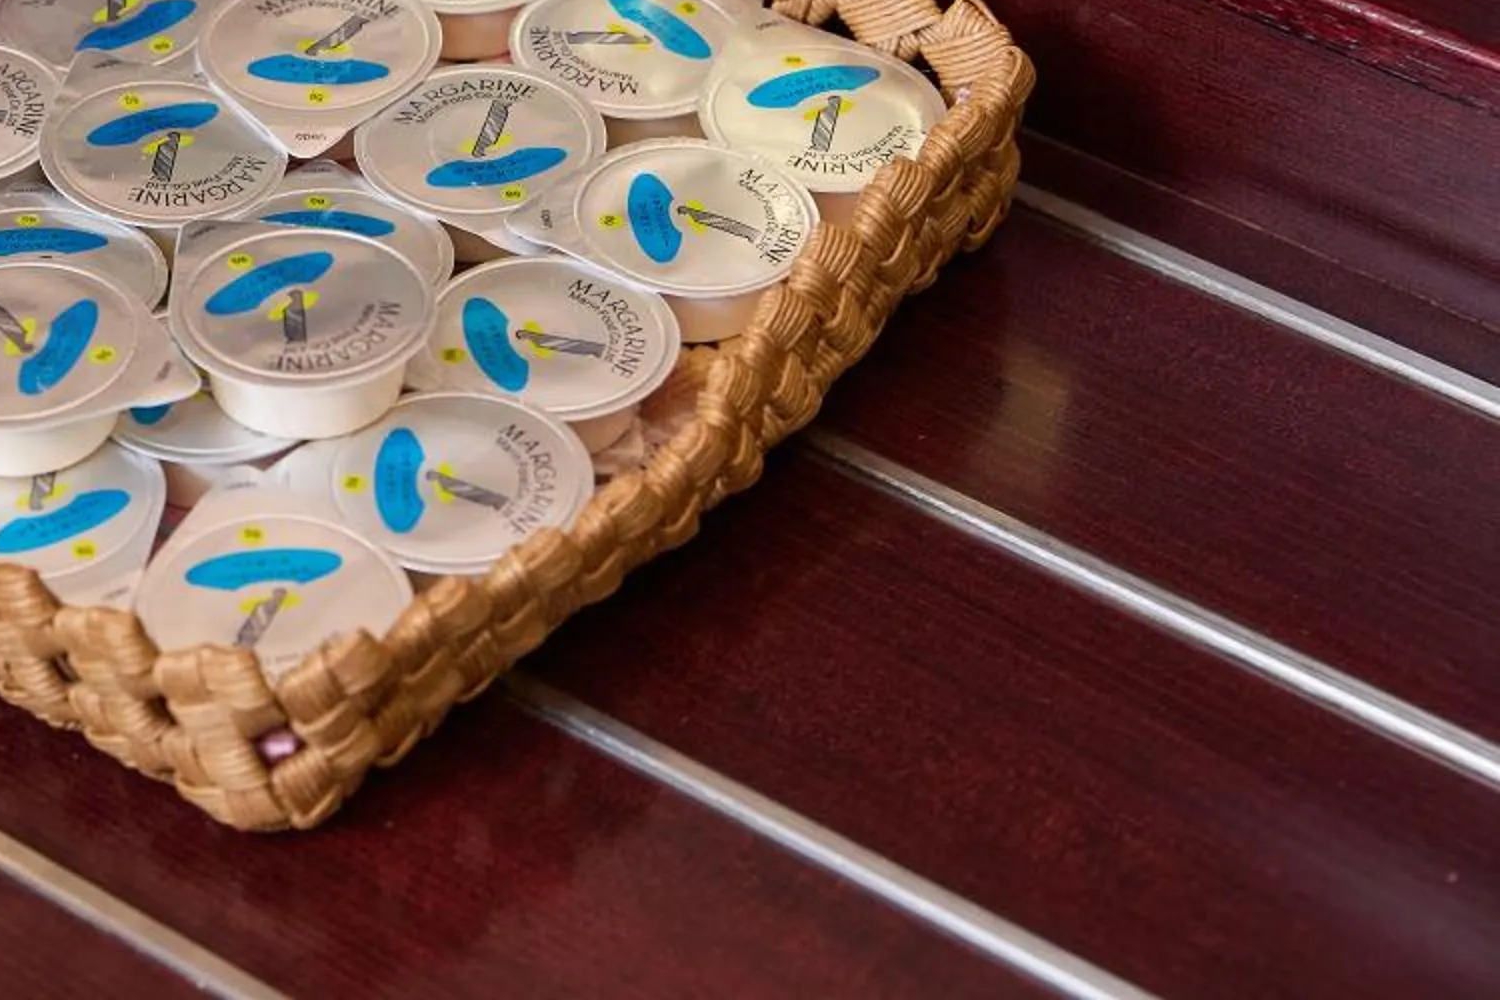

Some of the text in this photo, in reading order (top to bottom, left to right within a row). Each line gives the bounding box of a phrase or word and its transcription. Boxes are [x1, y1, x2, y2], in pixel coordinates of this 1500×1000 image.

[530, 26, 639, 95] MARGARINE
[393, 79, 538, 125] MARGARINE
[127, 155, 267, 206] MARGARINE
[269, 301, 402, 371] MARGARINE
[567, 278, 646, 379] MARGARINE
